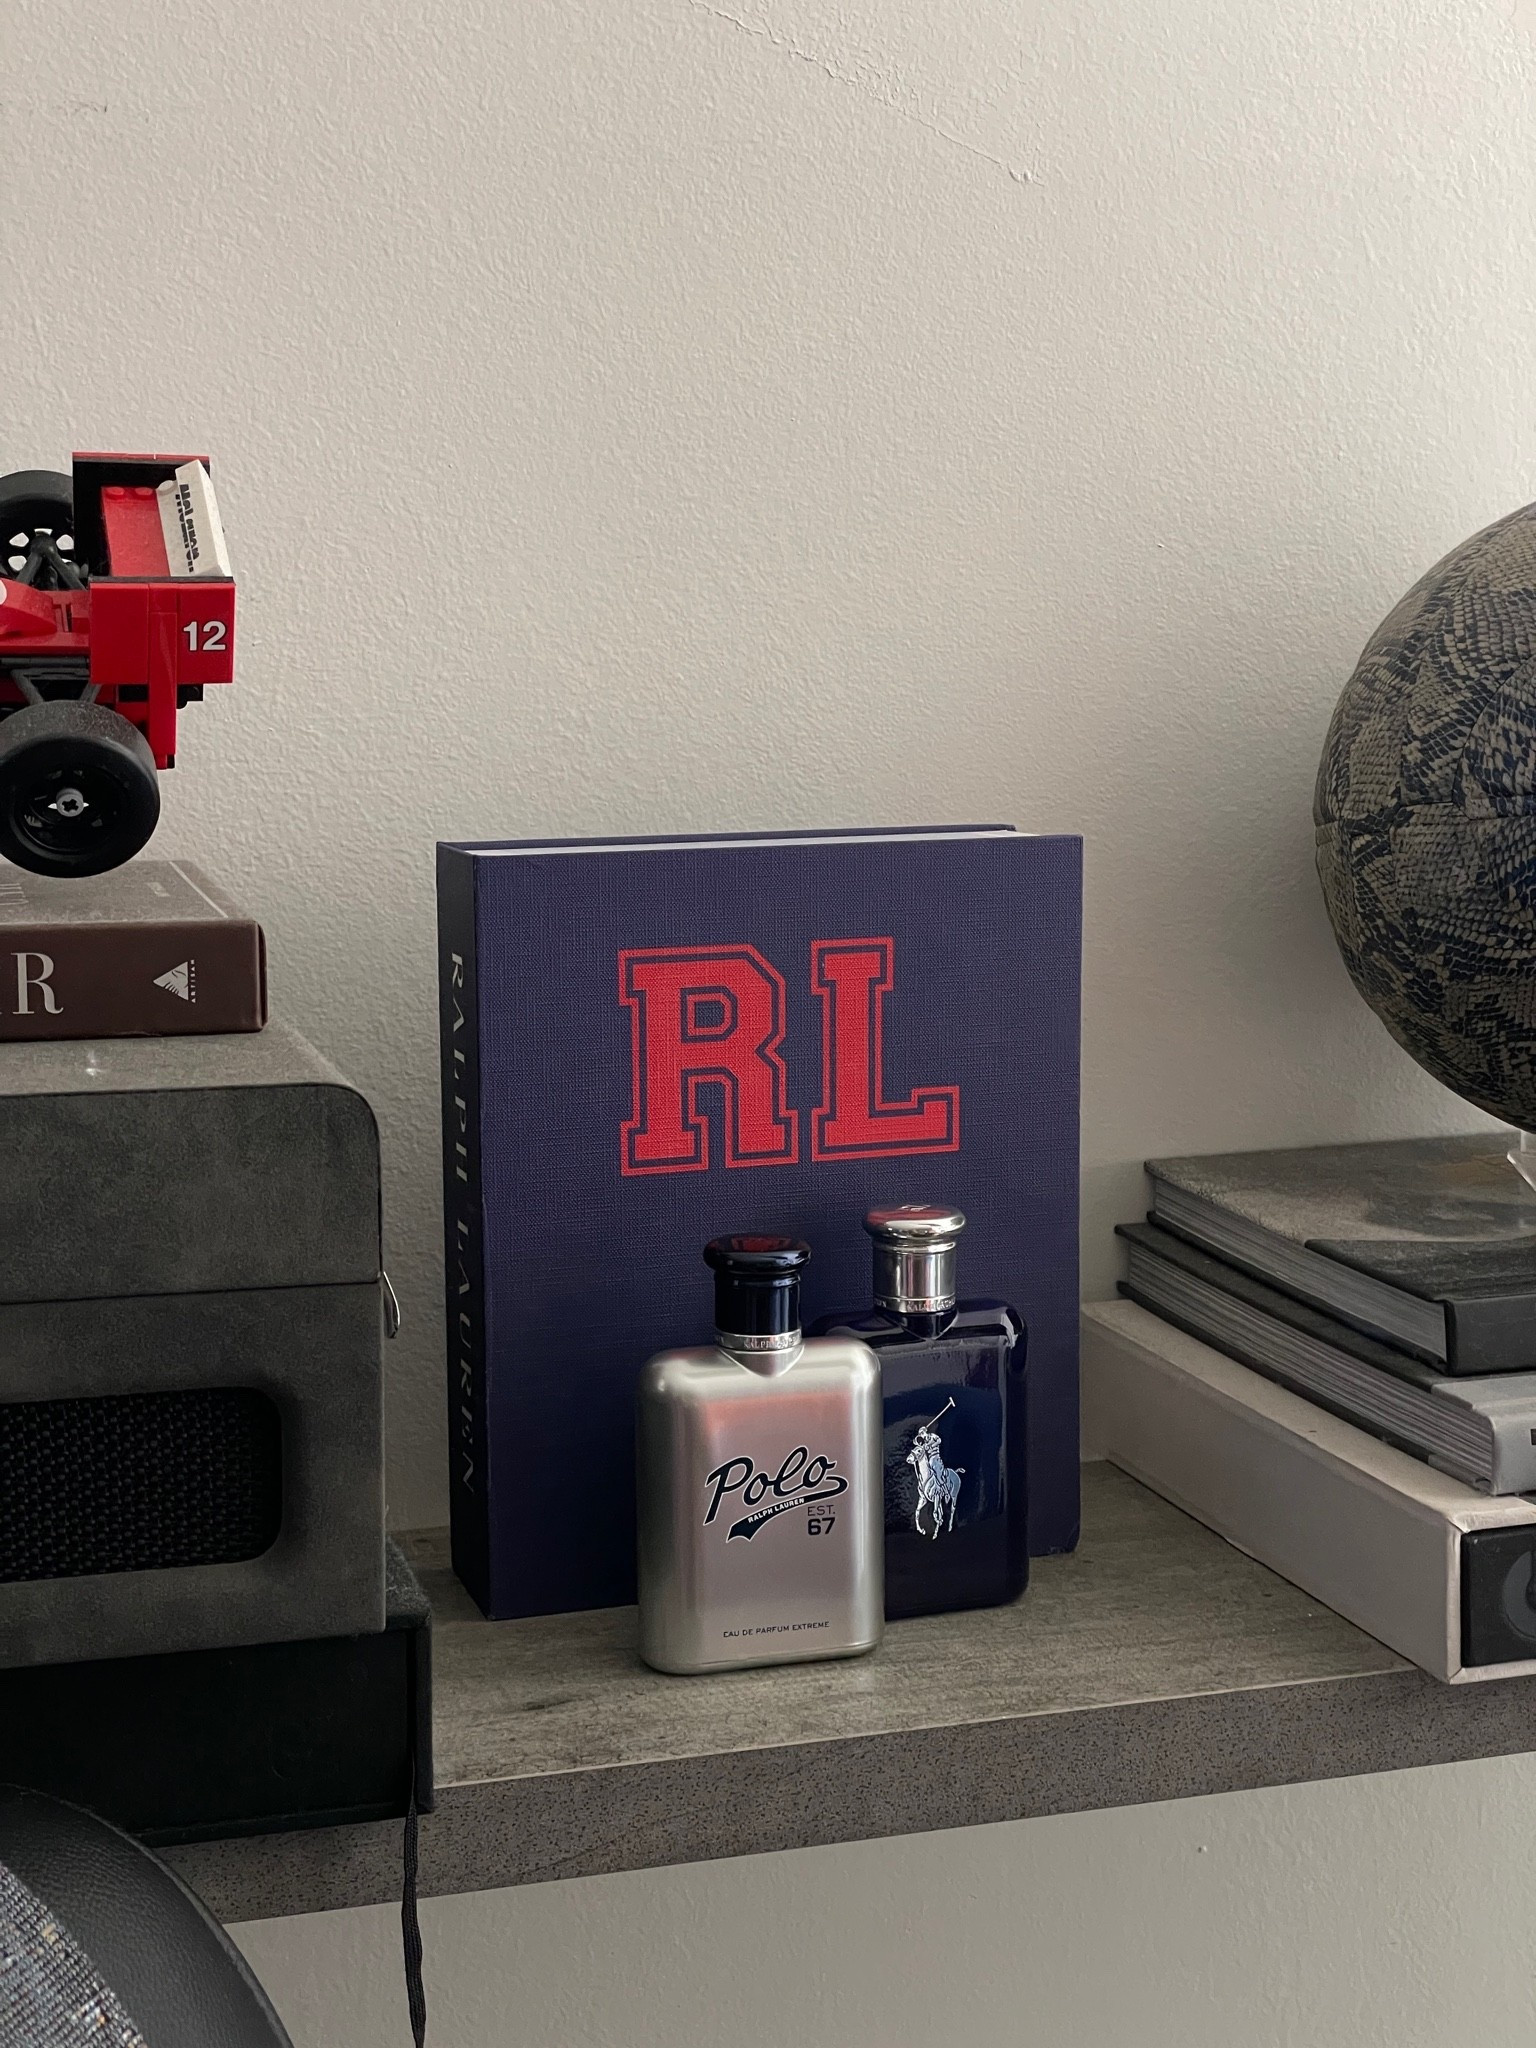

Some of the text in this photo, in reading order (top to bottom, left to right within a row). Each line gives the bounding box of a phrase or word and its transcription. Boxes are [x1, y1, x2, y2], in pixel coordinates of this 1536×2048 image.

[183, 621, 226, 652] 12
[0, 952, 64, 1015] R
[618, 936, 960, 1176] RL
[451, 952, 475, 1495] RALPH LAUREN
[703, 1445, 838, 1526] Polo
[747, 1497, 805, 1524] RALPH LAUREN
[807, 1504, 836, 1516] EST.
[807, 1517, 836, 1536] 67
[723, 1630, 740, 1638] EAU
[756, 1624, 790, 1634] PARFUM
[792, 1621, 830, 1631] EXTREME
